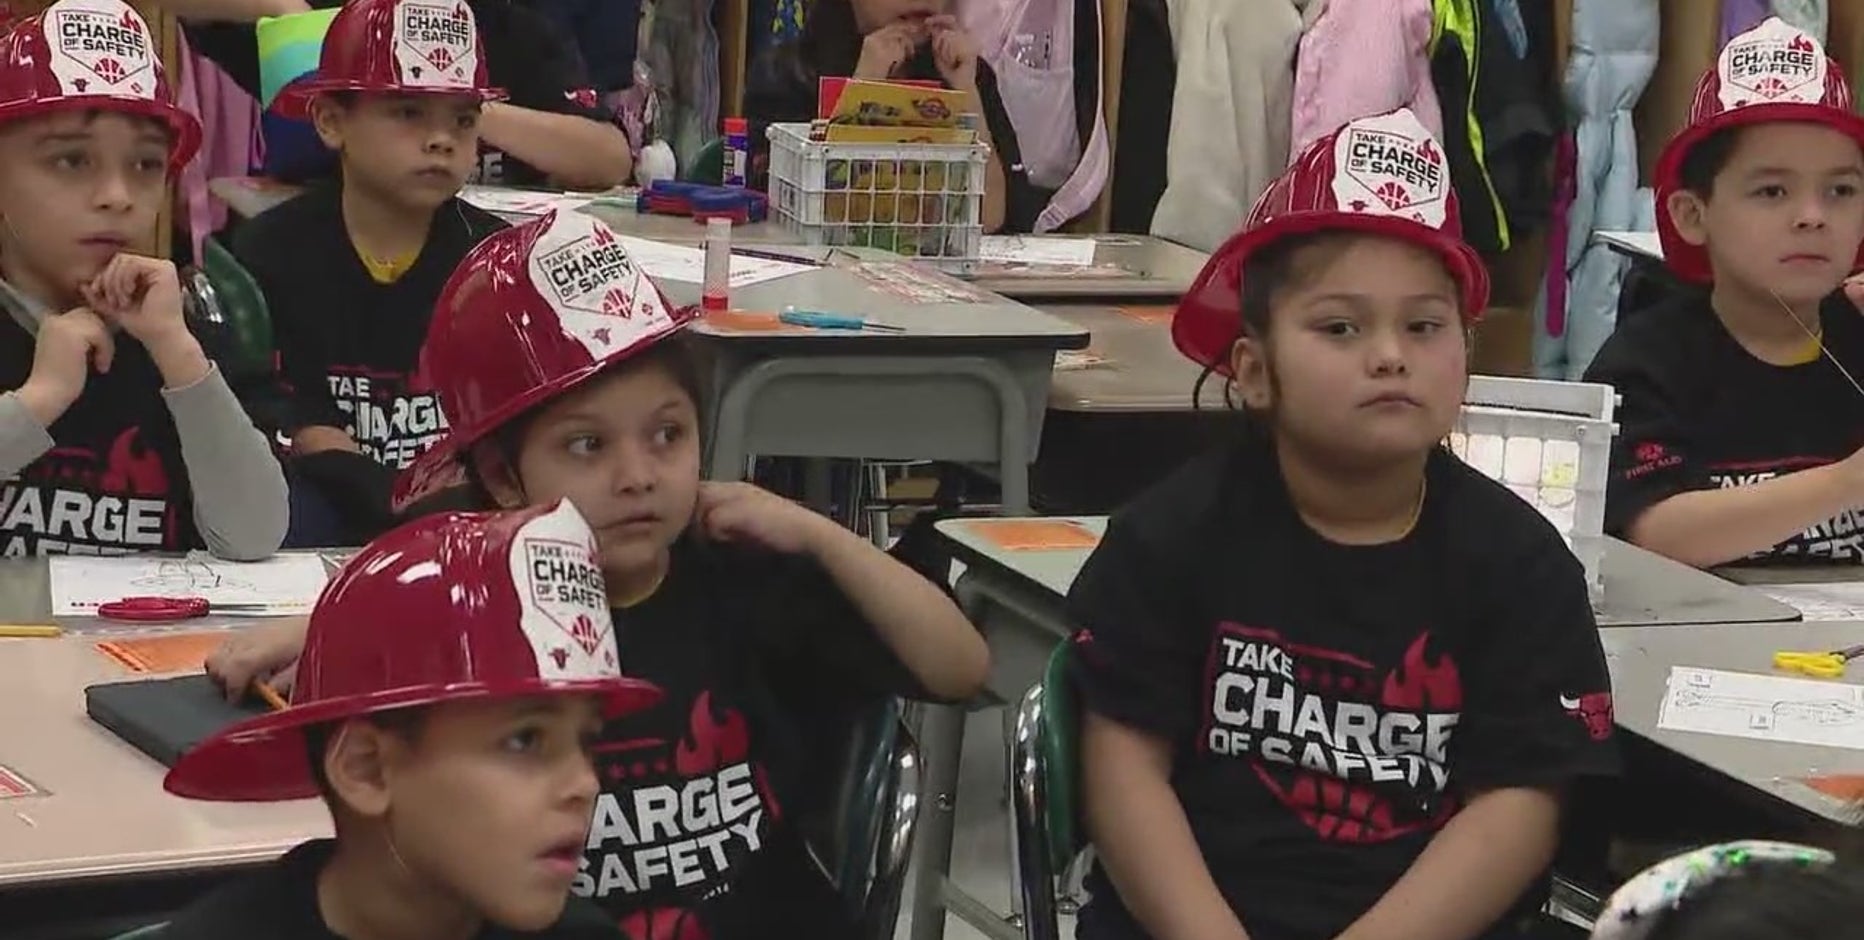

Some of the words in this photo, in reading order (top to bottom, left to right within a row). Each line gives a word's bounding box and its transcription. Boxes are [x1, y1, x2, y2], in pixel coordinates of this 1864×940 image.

[62, 14, 90, 22] TAKE
[407, 16, 469, 36] CHARGE
[62, 23, 144, 49] CHARGE
[421, 31, 468, 48] SAFETY
[64, 38, 79, 47] OF
[83, 39, 144, 60] SAFETY
[1732, 50, 1814, 68] CHARGE
[1748, 63, 1813, 77] SAFETY
[1356, 134, 1386, 143] TAKE
[1352, 143, 1440, 182] CHARGE
[1351, 159, 1366, 168] OF
[1371, 161, 1438, 193] SAFETY
[544, 248, 575, 269] TAKE
[551, 244, 626, 287] CHARGE
[560, 285, 576, 298] OF
[578, 260, 632, 293] SAFETY
[532, 545, 562, 558] TAKE
[536, 584, 551, 595] OF
[557, 585, 607, 610] SAFET
[1223, 637, 1295, 681] TAKE
[1213, 671, 1460, 763] CHARGE
[1209, 727, 1252, 756] OF
